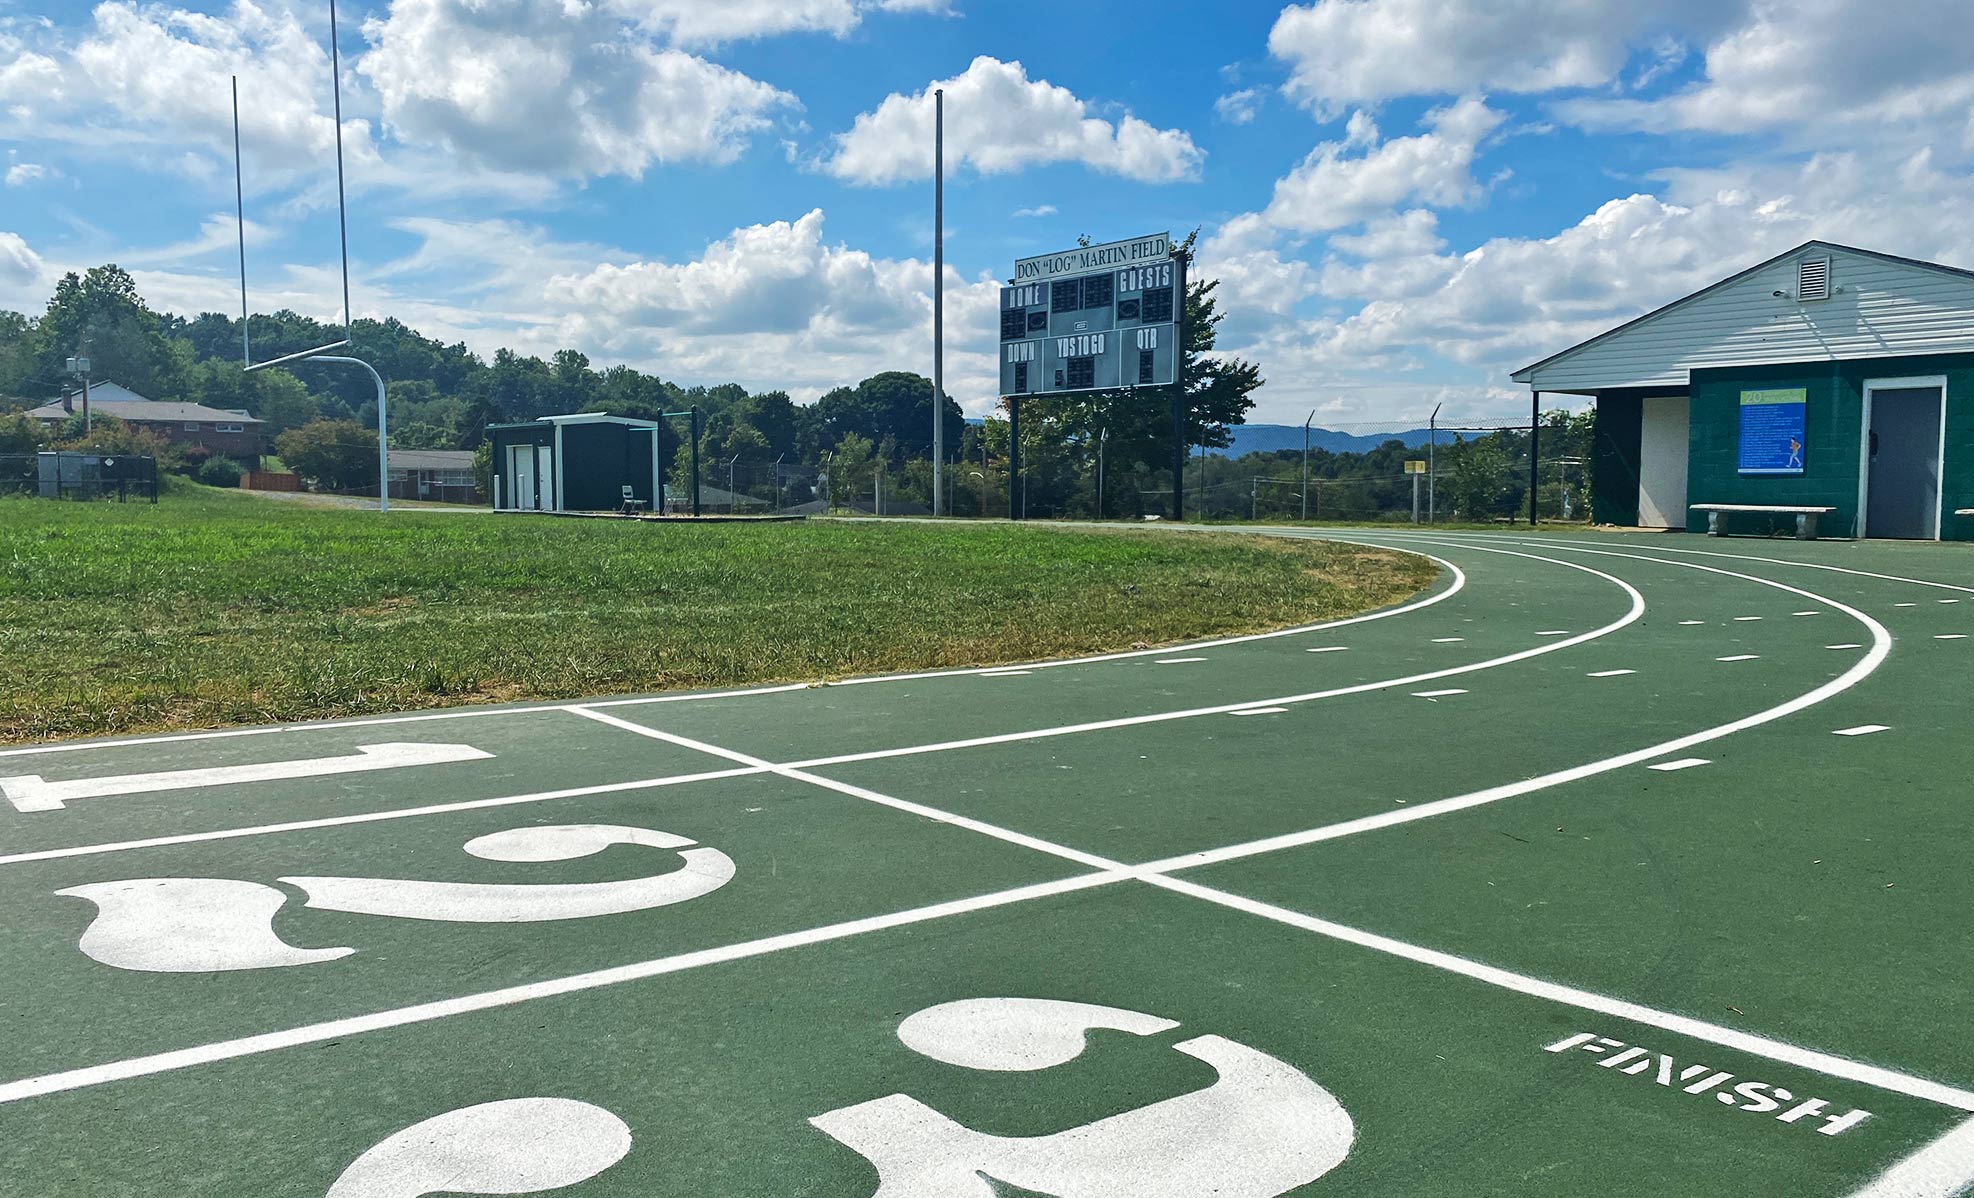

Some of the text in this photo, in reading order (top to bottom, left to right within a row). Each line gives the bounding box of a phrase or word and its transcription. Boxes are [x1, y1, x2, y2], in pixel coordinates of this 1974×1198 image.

[1017, 261, 1040, 279] DON
[1080, 245, 1127, 268] MARTIN
[1131, 238, 1165, 260] FIELD
[1120, 265, 1170, 292] GUESTS
[1009, 285, 1040, 308] HOME
[1007, 341, 1035, 363] DOWN
[1057, 334, 1105, 358] YDS TO GO
[1136, 328, 1158, 350] QTR
[0, 742, 497, 812] 1
[54, 824, 737, 973] 2
[1542, 1032, 1873, 1136] FINISH
